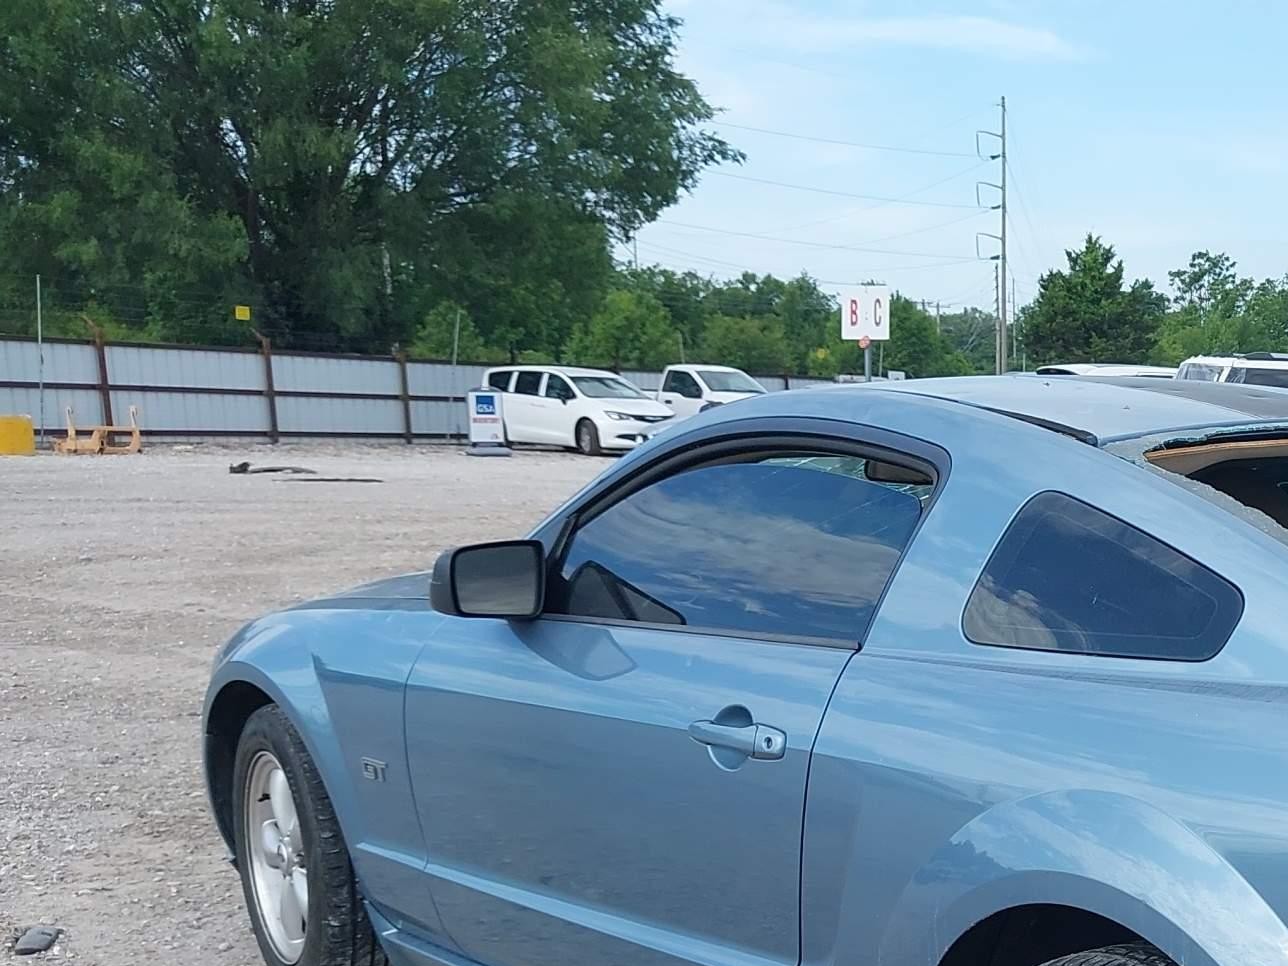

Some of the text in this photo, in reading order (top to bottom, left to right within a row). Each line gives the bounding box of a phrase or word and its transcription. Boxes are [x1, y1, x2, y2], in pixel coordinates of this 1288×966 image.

[850, 298, 882, 327] B C
[361, 755, 389, 783] GT
